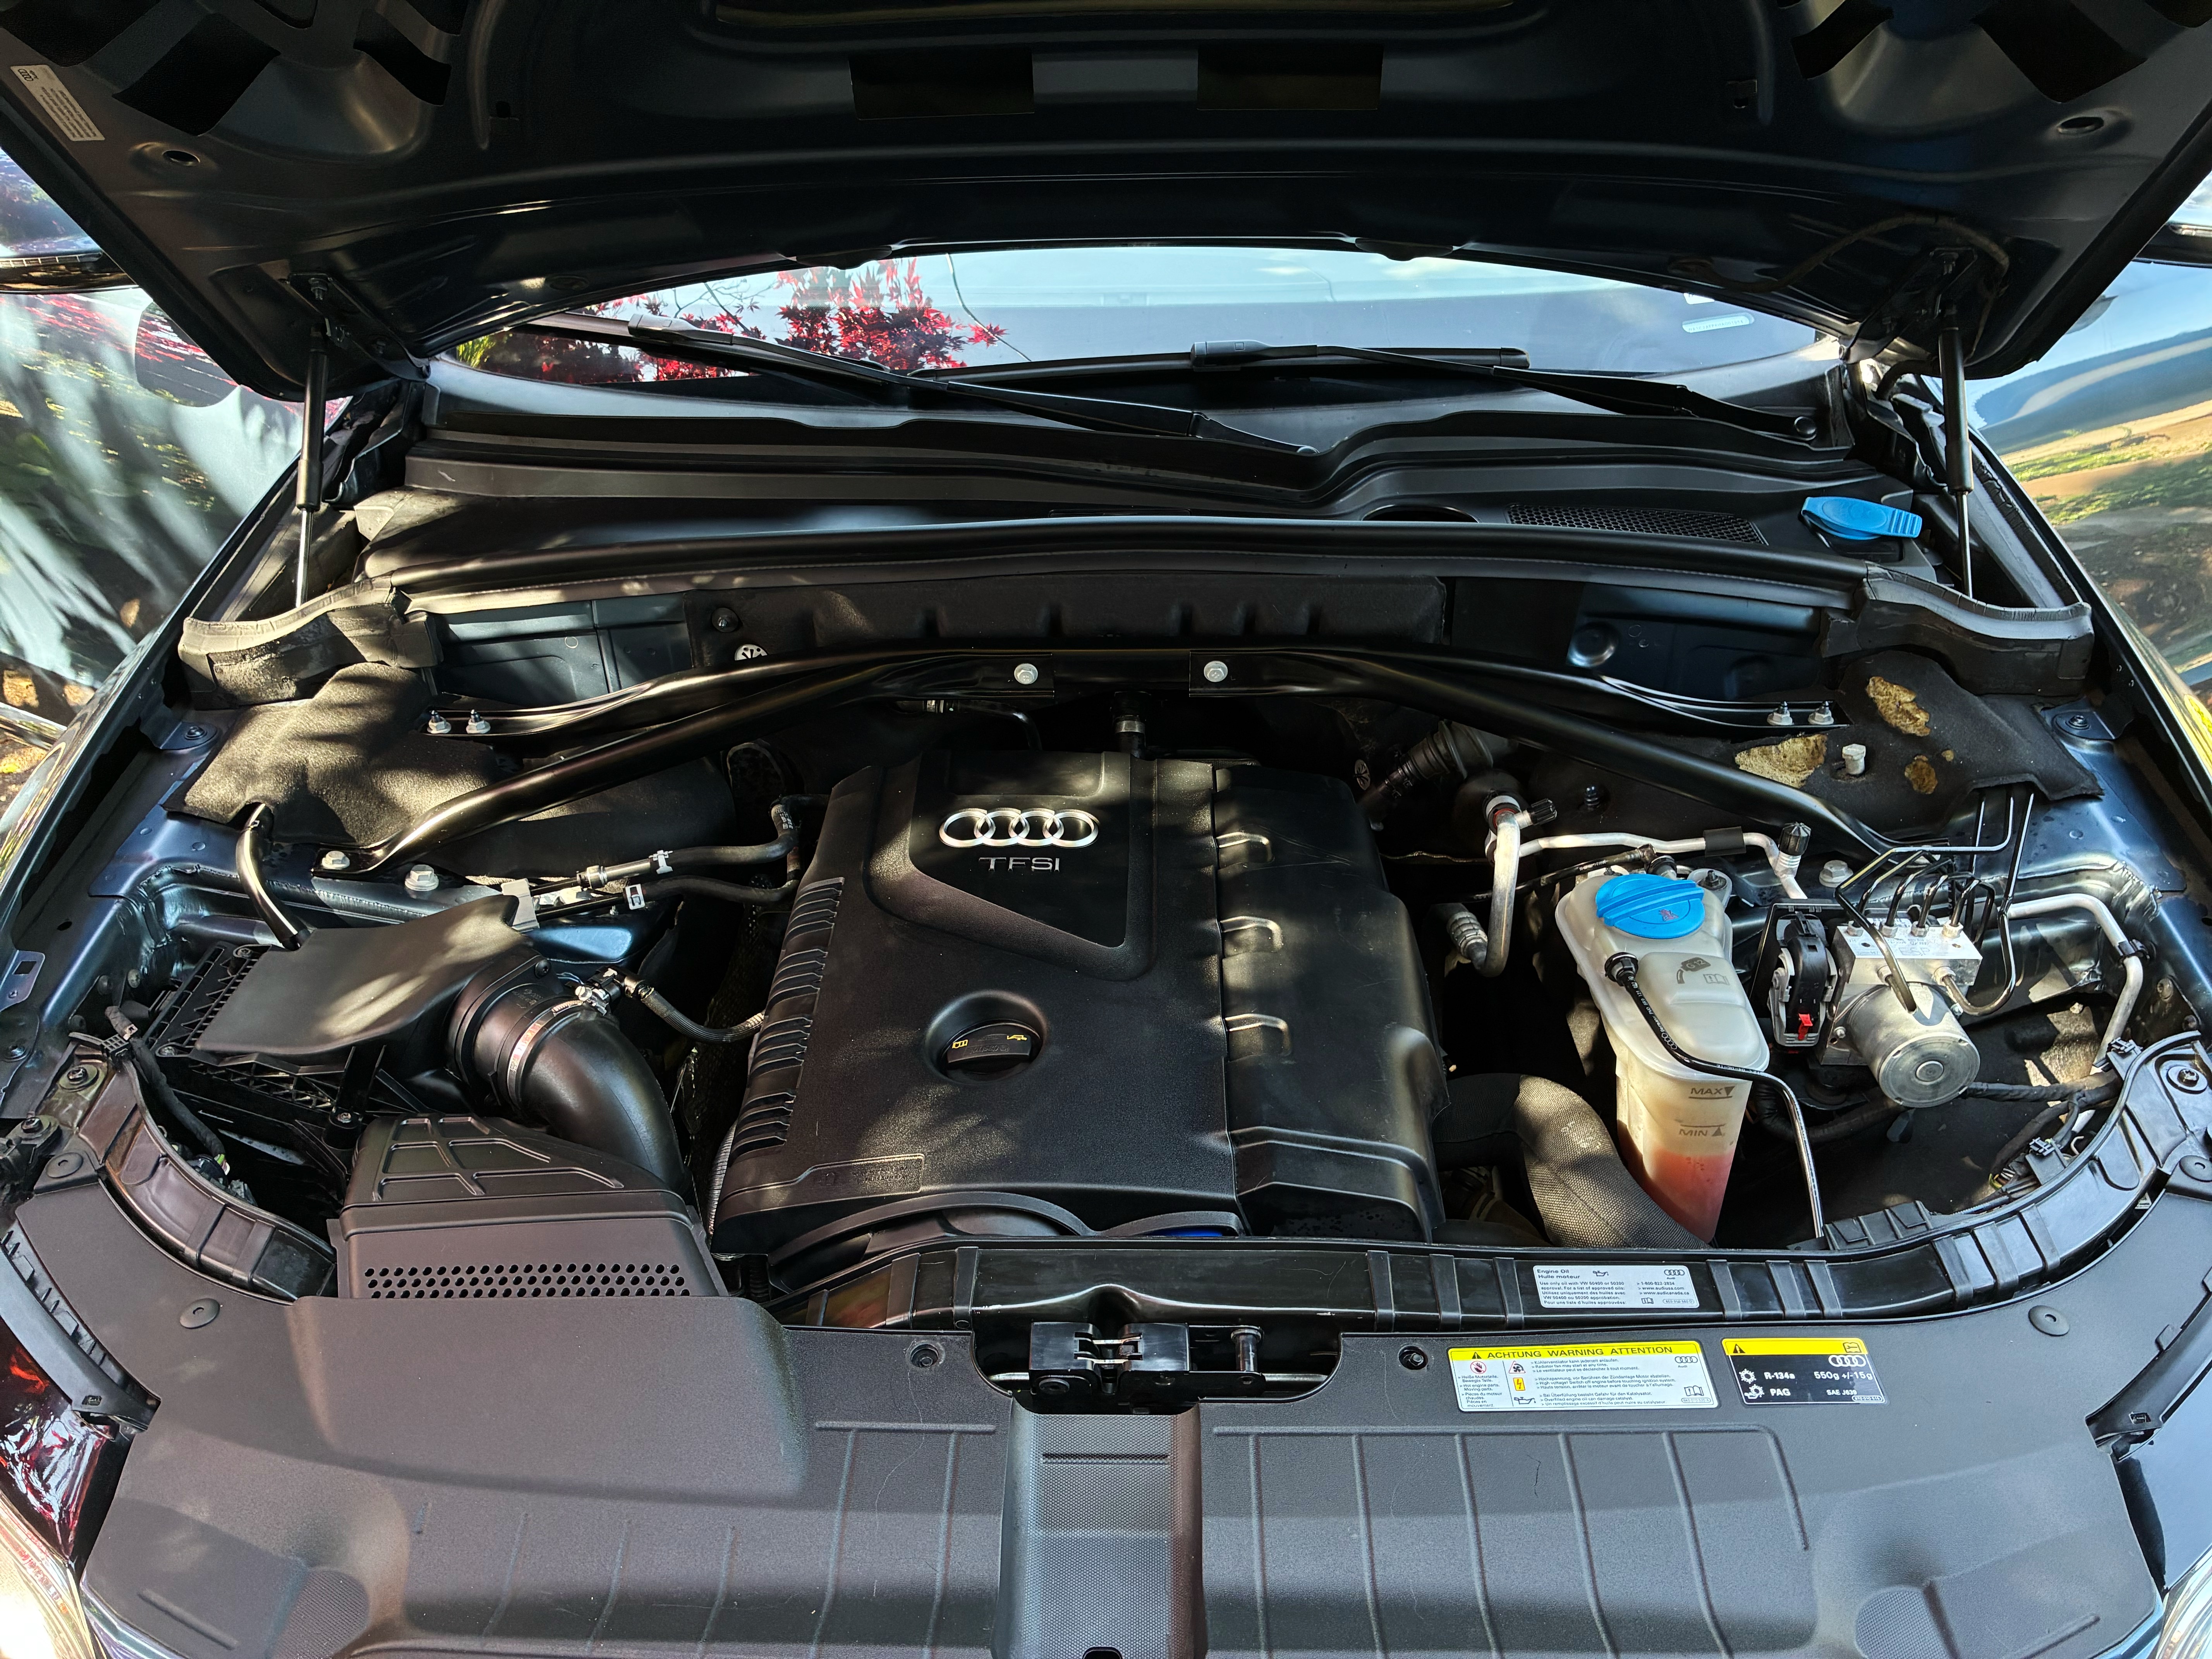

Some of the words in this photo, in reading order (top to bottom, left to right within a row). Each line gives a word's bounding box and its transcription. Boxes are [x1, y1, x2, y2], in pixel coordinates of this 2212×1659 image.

[979, 857, 1060, 871] TFSI
[1547, 1348, 1604, 1357] WARNING
[1610, 1346, 1673, 1355] ATTENTION
[1814, 1371, 1839, 1380] 550g
